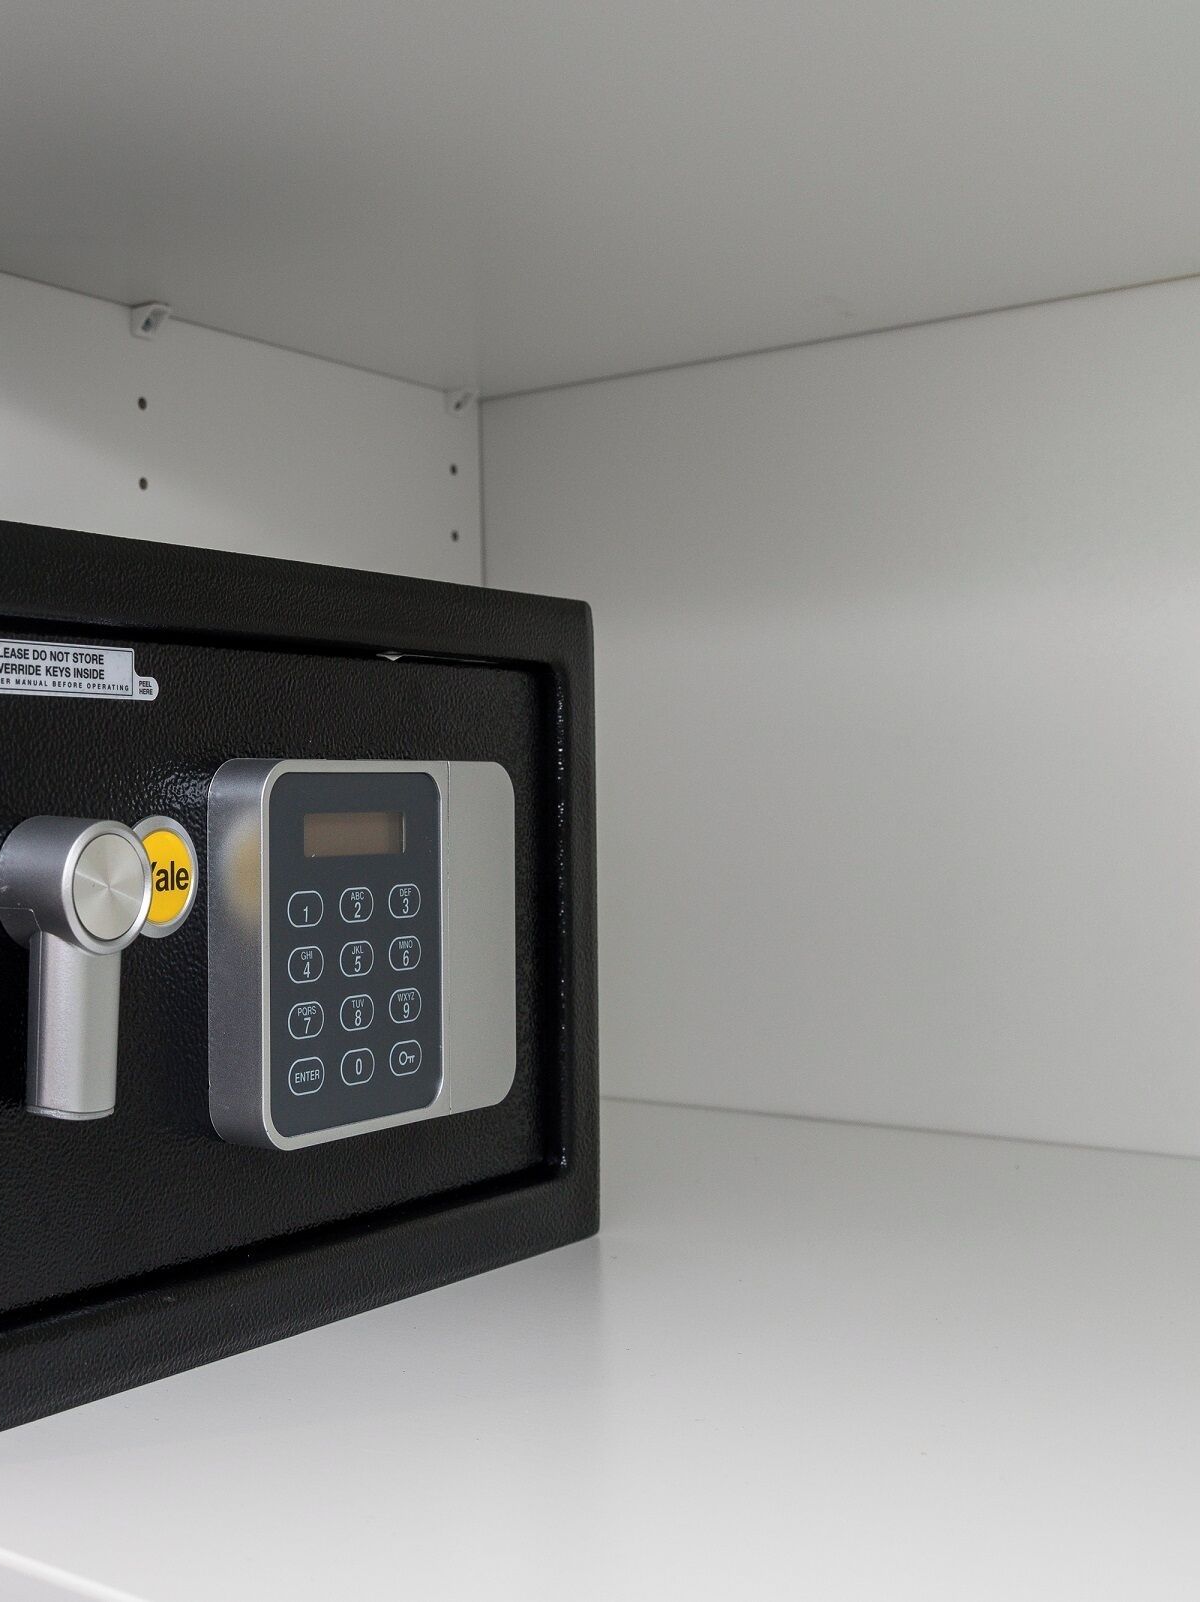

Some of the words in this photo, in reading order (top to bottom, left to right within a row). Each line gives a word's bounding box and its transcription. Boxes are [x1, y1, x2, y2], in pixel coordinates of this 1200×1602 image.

[32, 649, 47, 660] DO
[49, 650, 70, 662] NOT
[72, 652, 104, 665] STORE
[45, 666, 71, 678] KEYS
[73, 668, 105, 680] INSIDE
[15, 679, 48, 687] MANUAL
[52, 680, 83, 689] BEFORE
[86, 683, 129, 692] OPERATING
[138, 680, 152, 688] PEEL
[350, 891, 365, 901] ABC
[399, 888, 412, 897] DEF
[354, 902, 361, 918] 2
[402, 898, 409, 914] 3
[303, 906, 309, 923] 1
[351, 945, 364, 955] JKL
[398, 940, 413, 949] MNO
[300, 950, 313, 961] GHI
[402, 950, 410, 966] 6
[303, 962, 311, 978] 4
[354, 956, 362, 973] 5
[397, 991, 415, 1002] WXYZ
[297, 1005, 317, 1017] PQRS
[351, 999, 365, 1009] TUV
[403, 1002, 410, 1019] 9
[354, 1009, 362, 1027] 8
[304, 1017, 312, 1034] 7
[294, 1069, 320, 1084] ENTER
